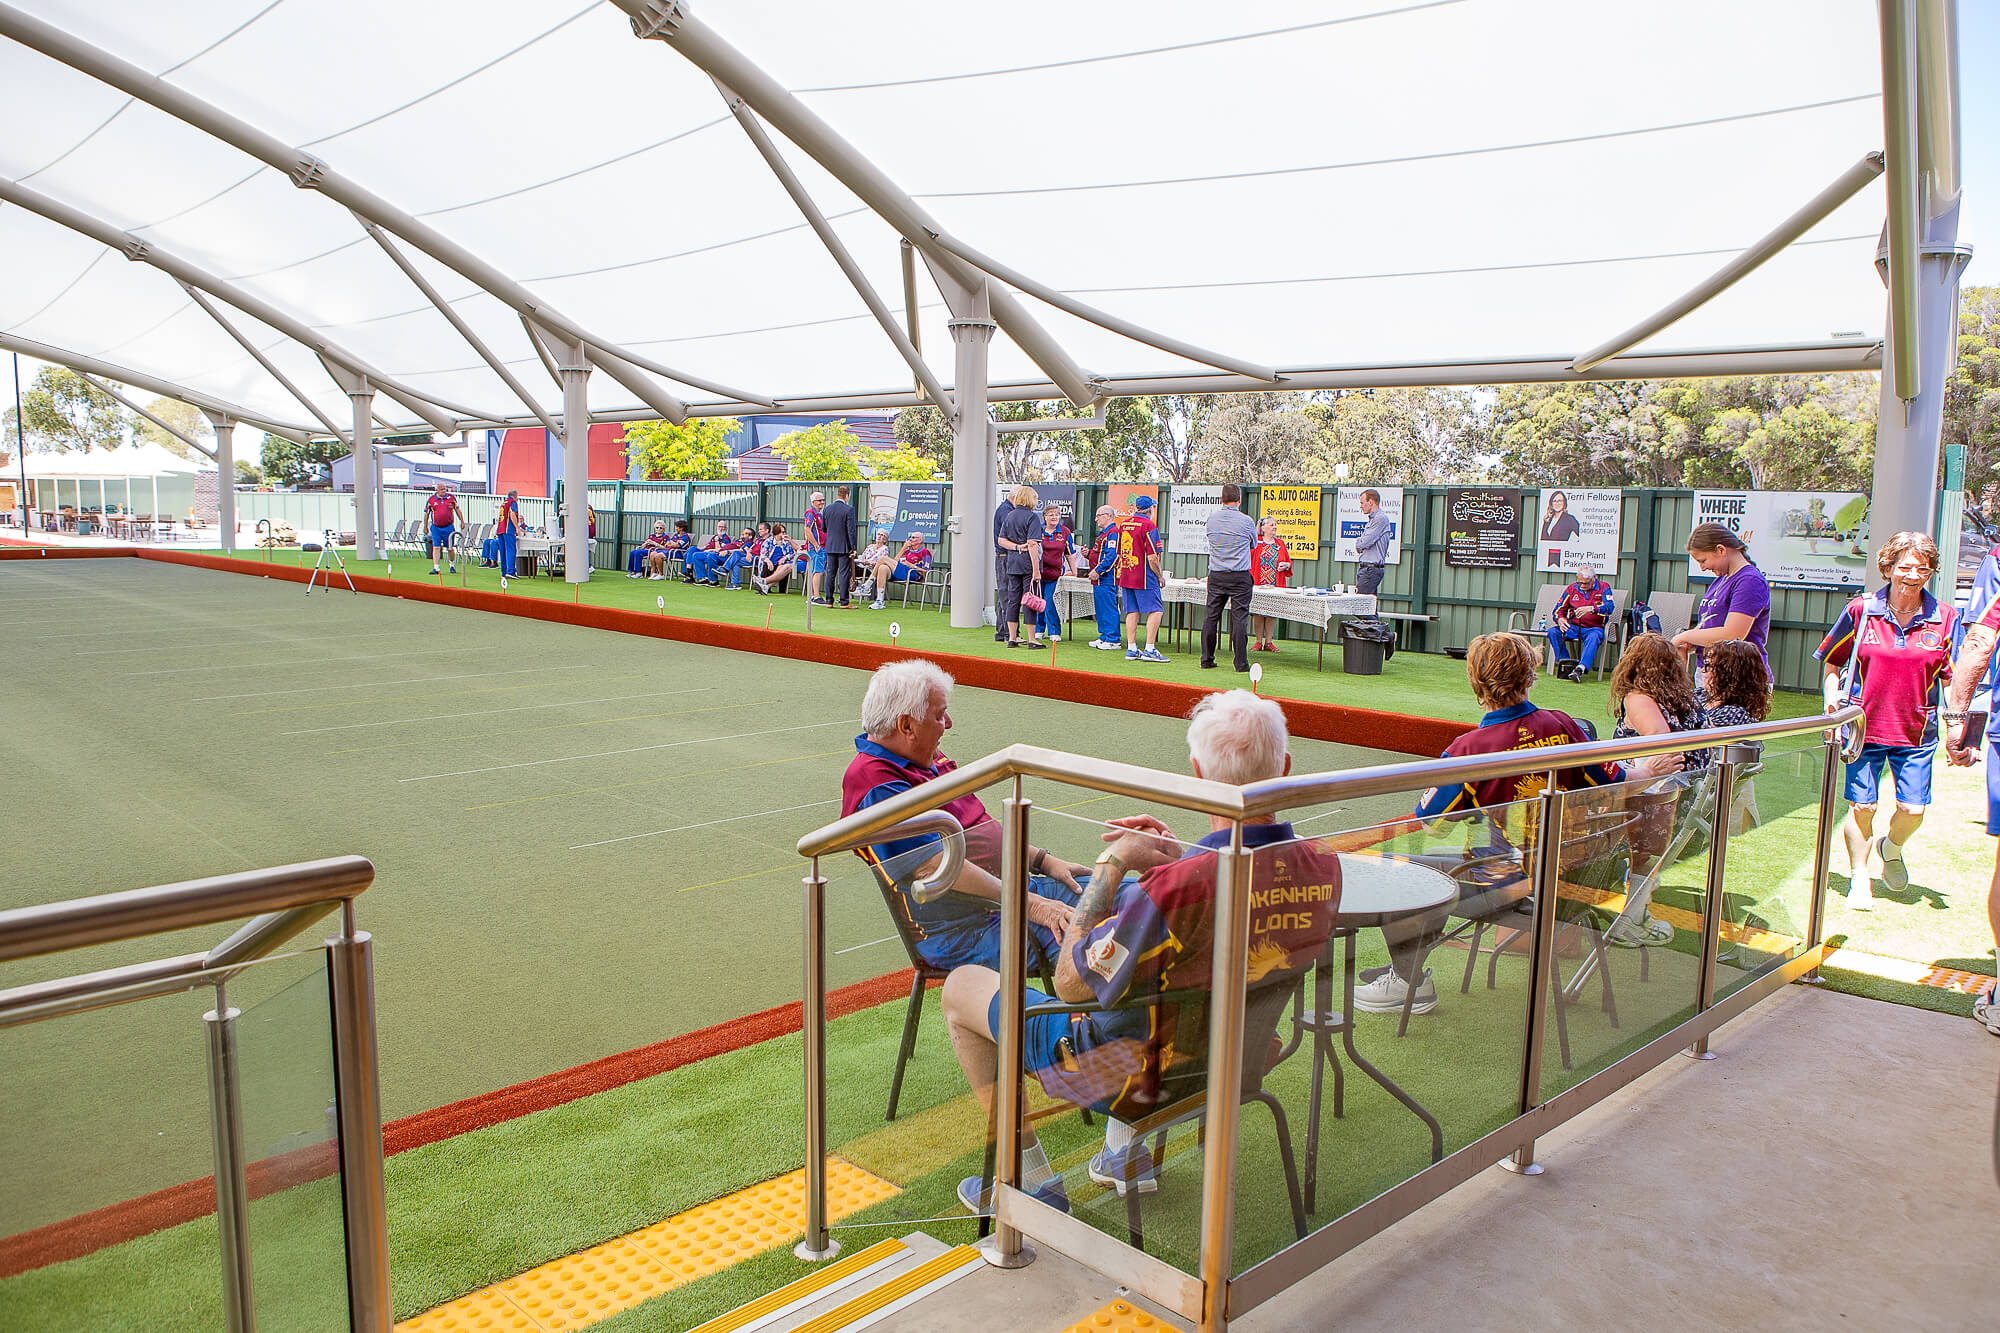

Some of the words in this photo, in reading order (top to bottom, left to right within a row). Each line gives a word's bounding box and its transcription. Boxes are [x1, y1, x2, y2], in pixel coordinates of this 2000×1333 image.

[1263, 489, 1277, 501] R.S.
[1278, 489, 1298, 501] AUTO
[1299, 489, 1319, 502] CARE
[1460, 491, 1504, 501] Smithies
[1566, 492, 1585, 501] Terri
[1587, 492, 1620, 501] Fellows
[1058, 505, 1073, 515] ZDA
[1700, 499, 1746, 515] WHERE
[907, 511, 939, 521] greenline
[1266, 508, 1290, 517] Servicing
[1295, 508, 1313, 517] Brakes
[1194, 519, 1207, 527] Goy
[1297, 519, 1316, 528] Repairs
[1727, 517, 1741, 532] IS
[1296, 542, 1316, 552] 2743
[1564, 550, 1585, 559] Barry
[1586, 551, 1606, 560] Plant
[892, 624, 897, 635] 2
[1507, 733, 1569, 751] ENHAM
[1250, 884, 1333, 909] AKENHAM
[1254, 912, 1313, 935] LIONS
